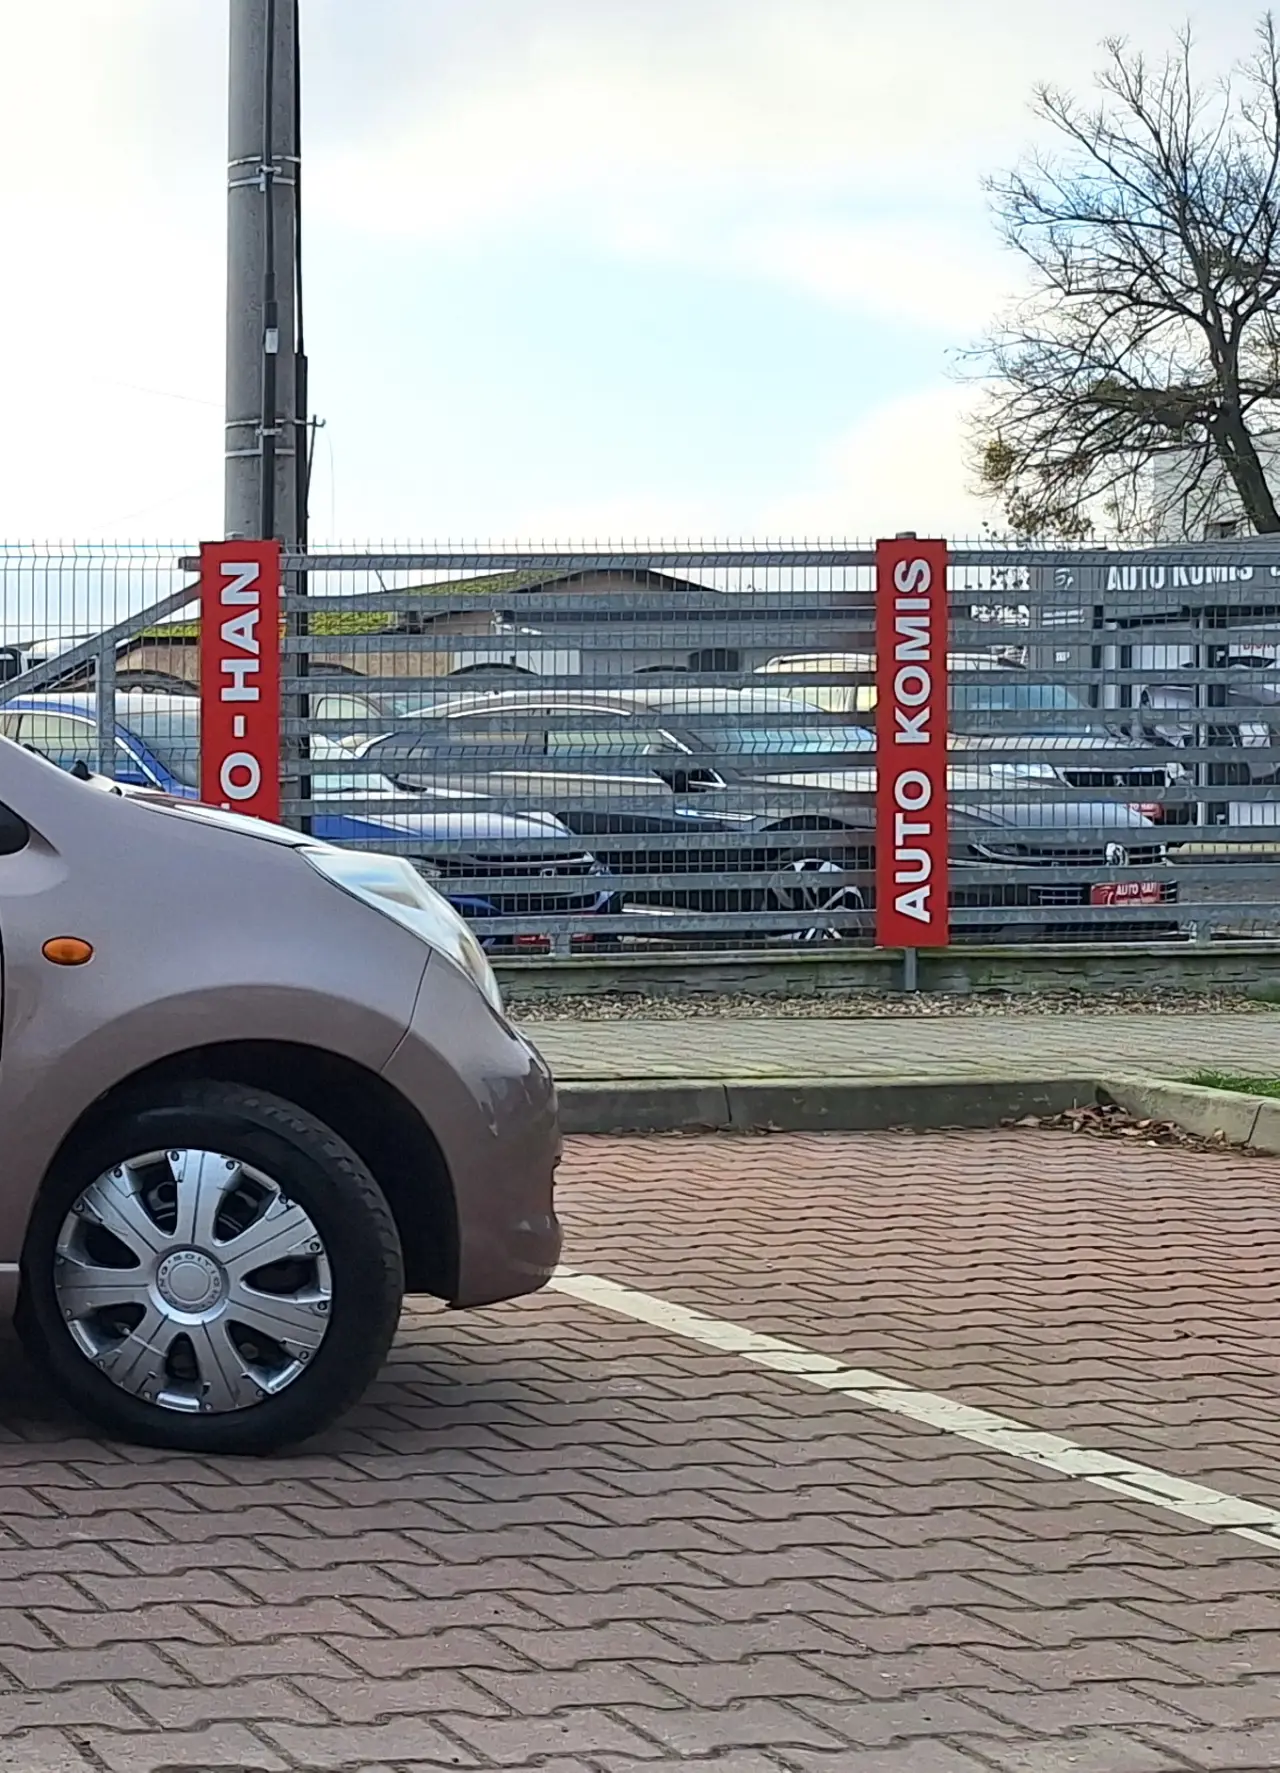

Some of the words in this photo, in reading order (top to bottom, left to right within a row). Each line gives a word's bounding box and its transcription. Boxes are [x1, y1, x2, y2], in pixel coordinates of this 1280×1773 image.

[894, 558, 931, 744] KOMIS
[220, 751, 261, 810] O
[894, 769, 932, 924] AUTO
